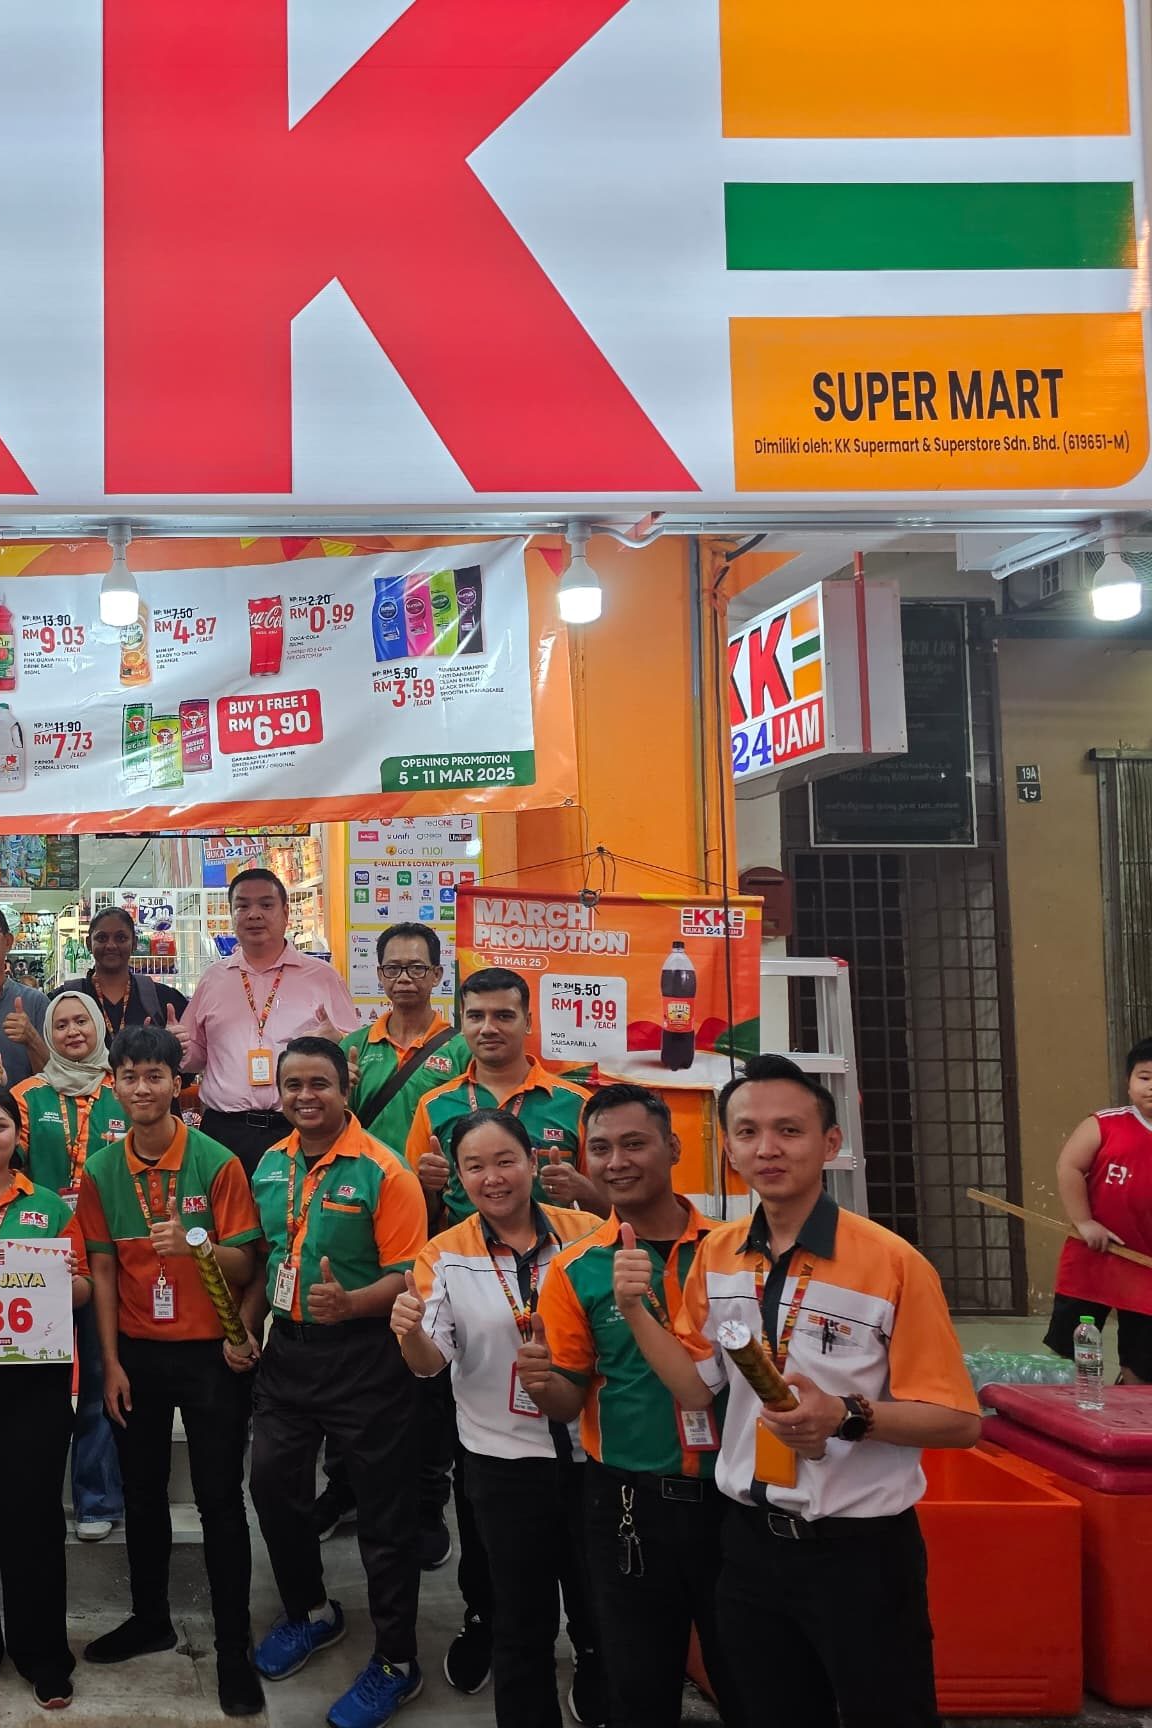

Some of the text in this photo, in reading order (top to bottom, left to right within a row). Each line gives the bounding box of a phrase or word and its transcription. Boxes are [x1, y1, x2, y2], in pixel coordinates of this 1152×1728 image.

[812, 368, 1064, 422] SUPER MART
[754, 430, 1131, 457] Dimiliki oleh: KK Supermart & Superstore Sdn. Bhd. (619651-M)
[154, 616, 217, 644] RM4.87
[289, 603, 354, 633] RM0.99
[22, 626, 85, 653] RM9.03
[229, 694, 308, 715] BUY 1 FREE 1
[373, 678, 435, 708] RM3.59
[228, 710, 311, 747] RM6.90
[732, 703, 820, 775] 24 JAM
[33, 731, 93, 759] RM7.73
[401, 755, 511, 768] OPENING PROMOTION
[398, 771, 409, 785] 5
[422, 770, 436, 784] 11
[439, 769, 474, 784] MAR
[476, 767, 515, 781] 2025
[225, 847, 243, 857] 24
[474, 899, 595, 931] MARCH
[692, 909, 732, 928] KK
[474, 926, 629, 956] PROMOTION
[706, 926, 722, 936] 24
[493, 956, 504, 965] 31
[504, 956, 528, 966] MAR
[528, 957, 542, 968] 25
[551, 997, 617, 1029] RM1.99
[594, 1021, 617, 1030] /EACH
[24, 1212, 44, 1223] KK
[0, 1272, 46, 1288] JAYA
